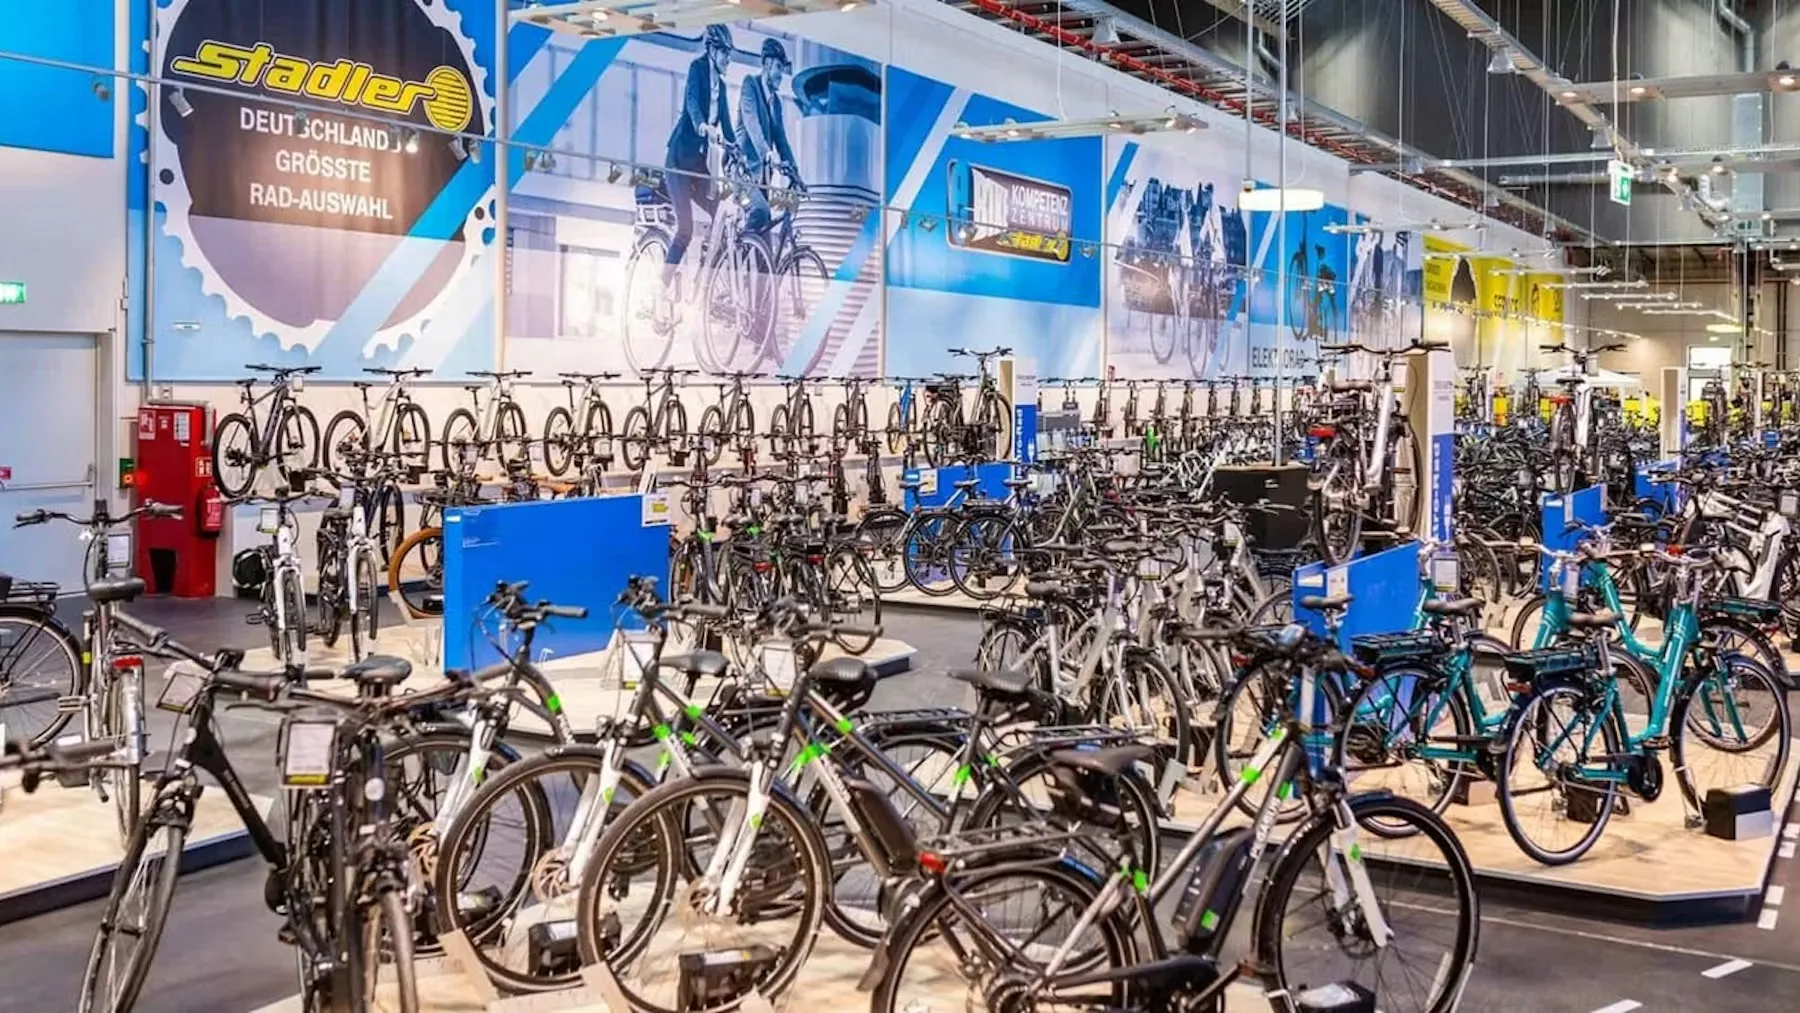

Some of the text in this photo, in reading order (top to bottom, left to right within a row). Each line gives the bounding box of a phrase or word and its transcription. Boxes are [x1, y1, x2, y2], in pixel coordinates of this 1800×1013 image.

[171, 41, 438, 115] stadler
[240, 107, 401, 153] DEUTCHLAND
[275, 149, 371, 183] GRÖSSTE
[250, 182, 393, 220] RAD-AUSWAHL
[1011, 183, 1068, 216] KOMPETENZ
[1252, 346, 1304, 369] ELEKTORAD
